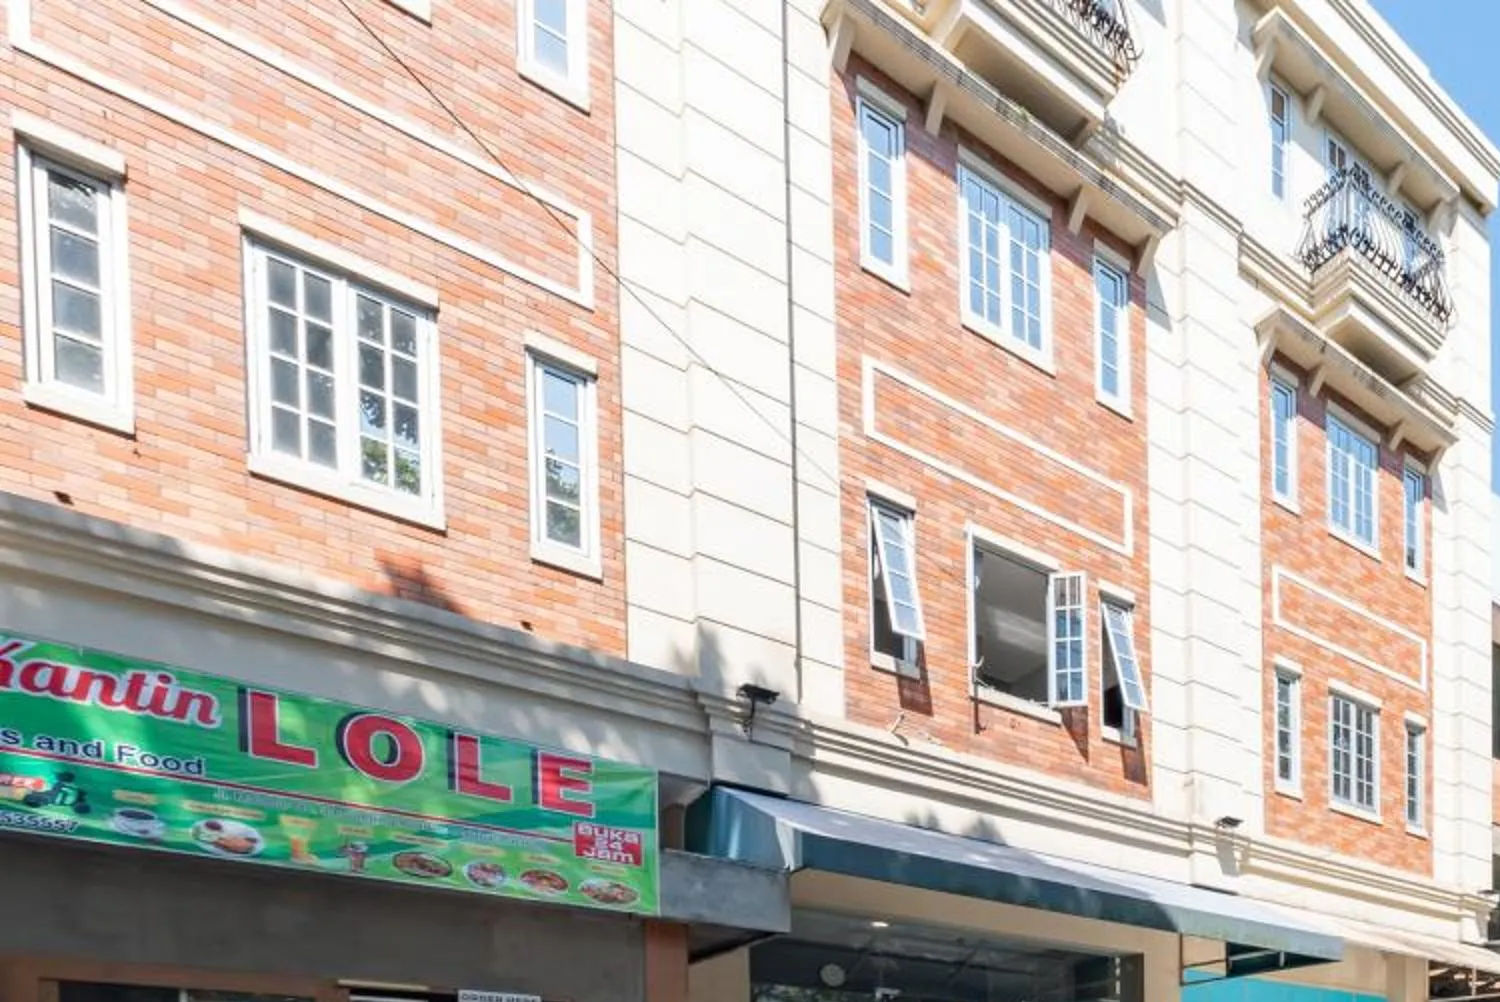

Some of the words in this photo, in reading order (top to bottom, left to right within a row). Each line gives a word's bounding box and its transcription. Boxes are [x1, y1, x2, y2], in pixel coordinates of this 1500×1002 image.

[36, 735, 103, 760] and
[115, 744, 206, 776] Food
[238, 686, 596, 818] LOLE
